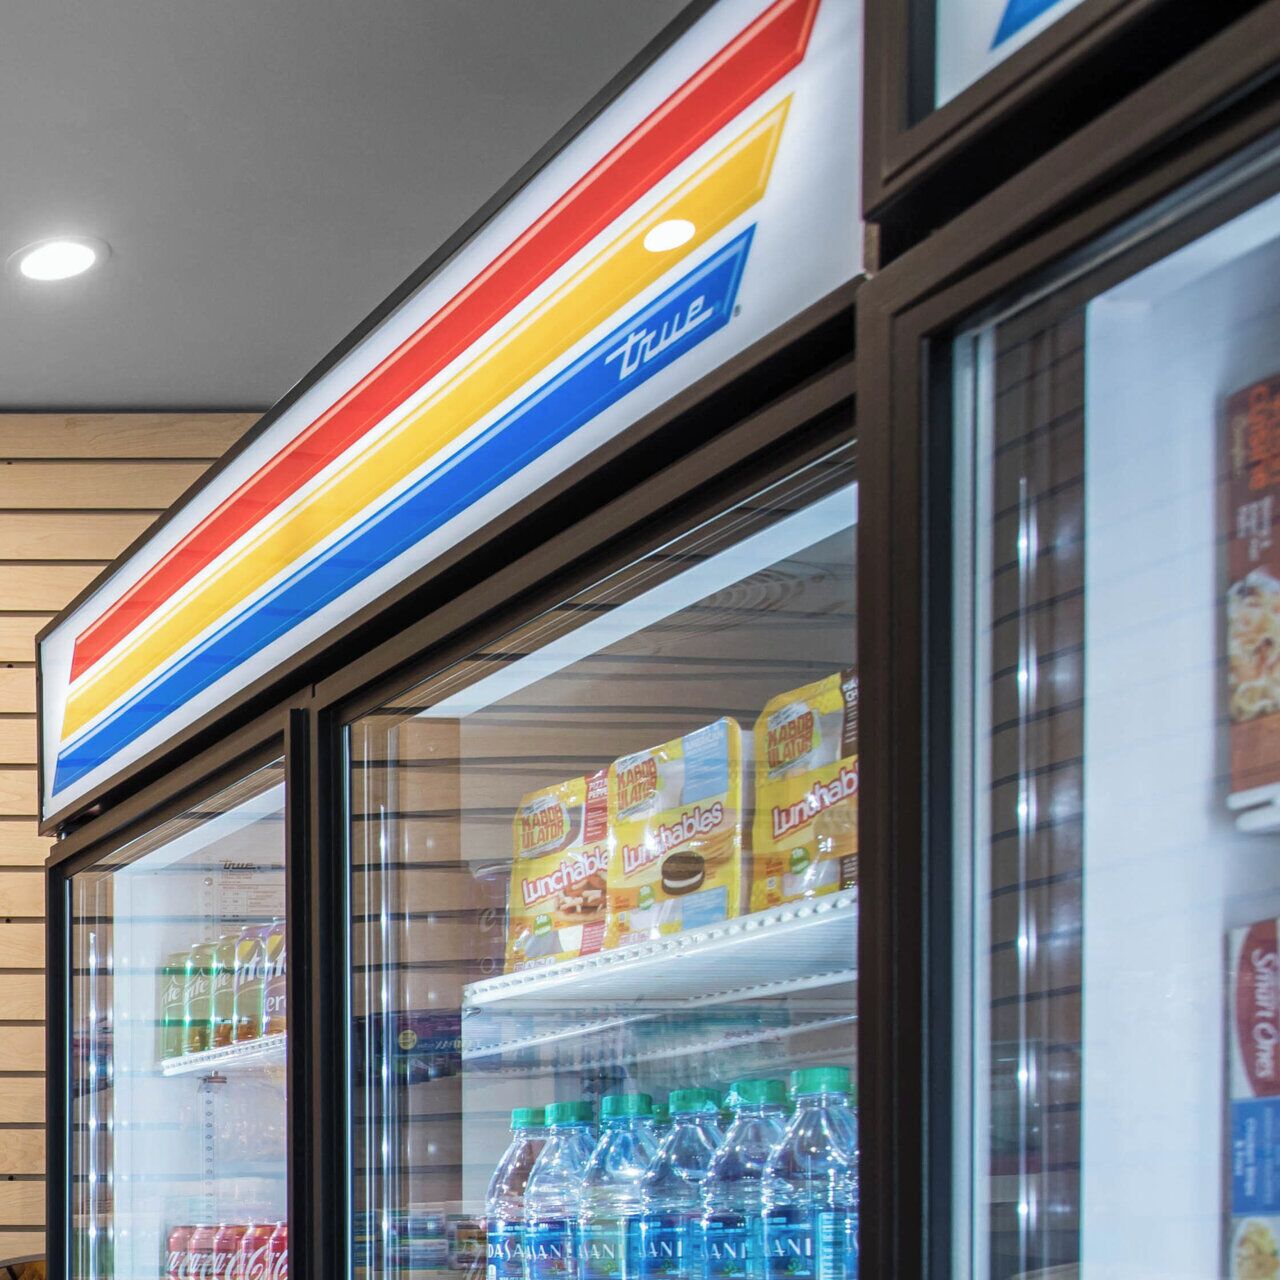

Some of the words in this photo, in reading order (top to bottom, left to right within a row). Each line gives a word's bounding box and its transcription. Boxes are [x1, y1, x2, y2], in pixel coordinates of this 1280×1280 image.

[604, 294, 714, 381] true
[522, 847, 608, 906] Lunchable
[488, 1242, 525, 1261] DASA
